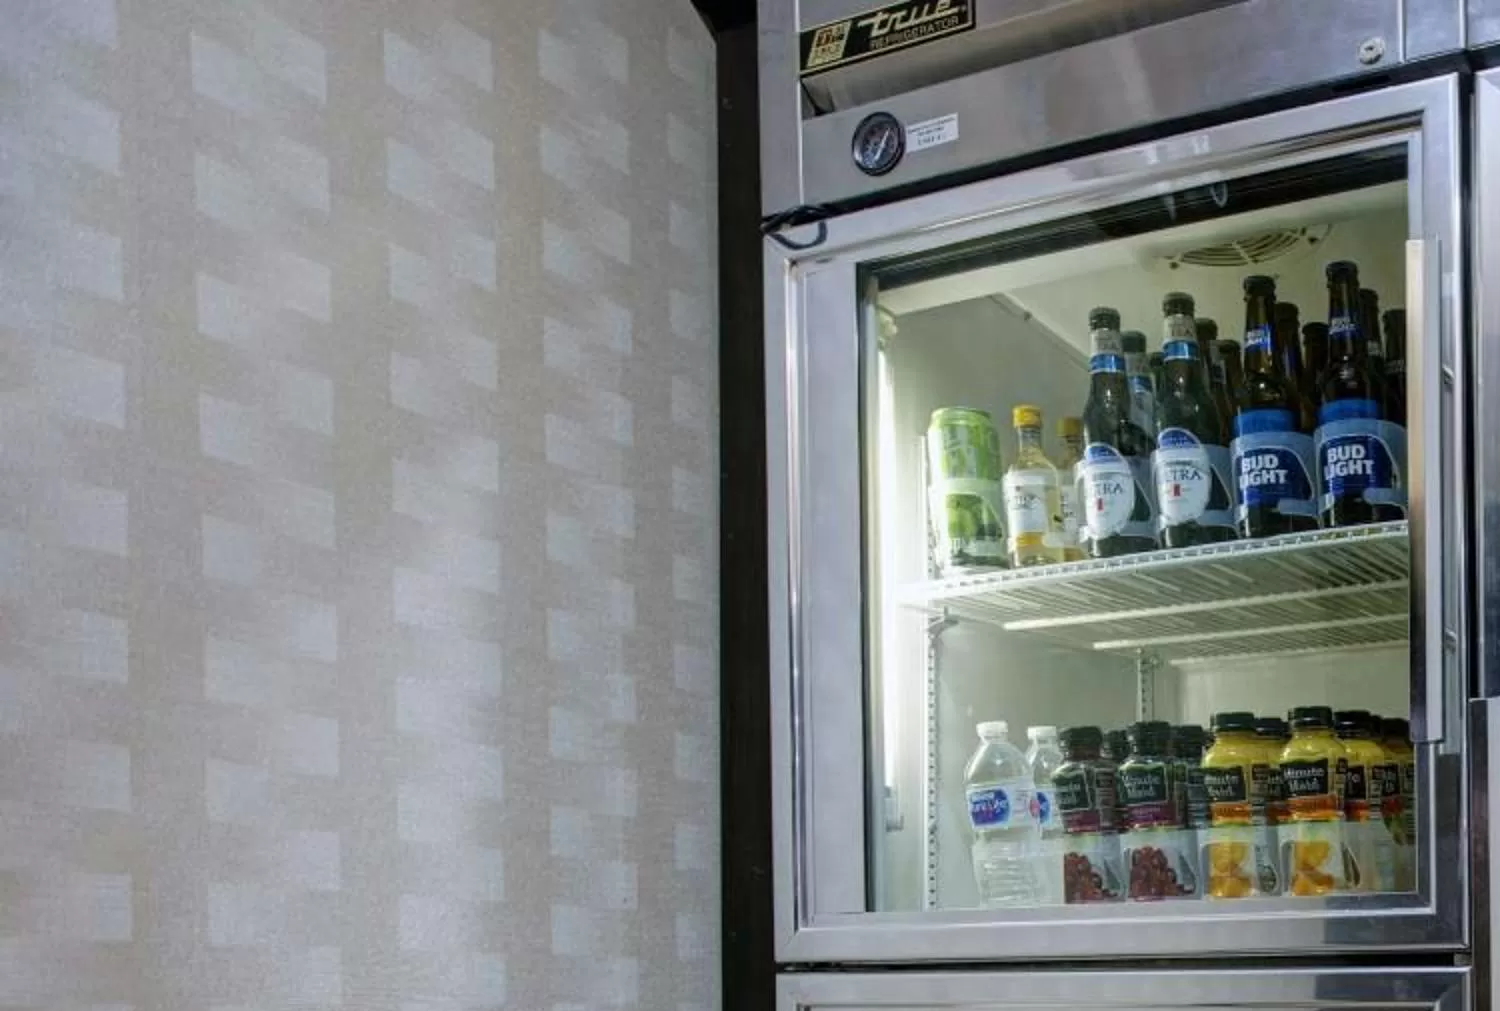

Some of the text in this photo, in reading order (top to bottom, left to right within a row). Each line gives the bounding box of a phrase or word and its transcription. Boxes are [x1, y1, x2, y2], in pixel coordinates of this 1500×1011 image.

[869, 15, 960, 49] REFGERATOR
[1326, 443, 1367, 463] BUD
[1241, 454, 1279, 473] BUD
[1323, 459, 1375, 481] LIGHT
[1239, 469, 1289, 489] LIGHT
